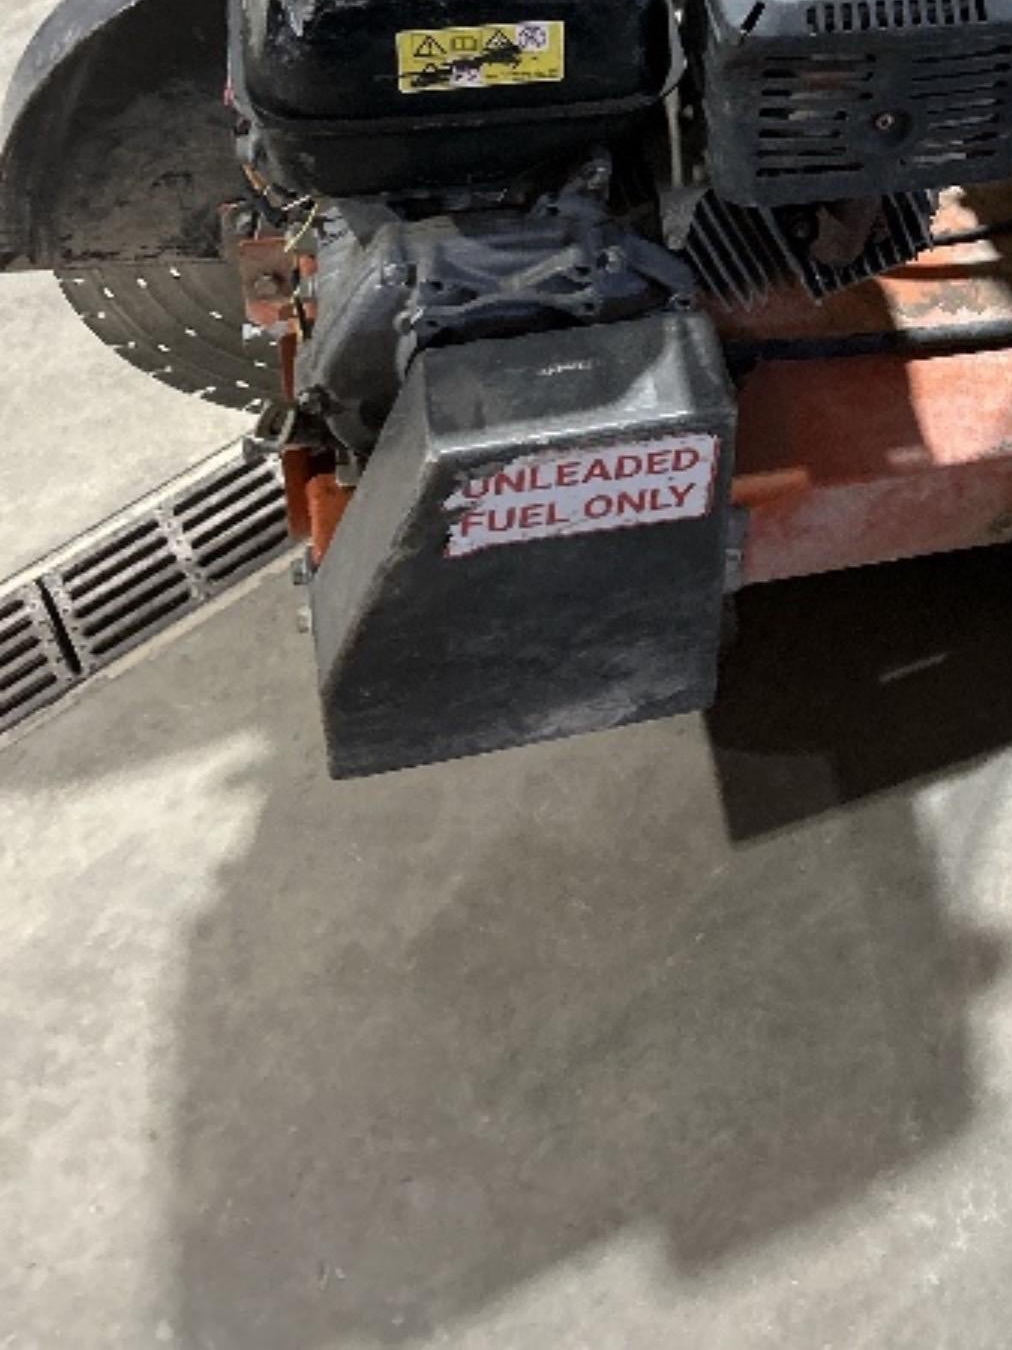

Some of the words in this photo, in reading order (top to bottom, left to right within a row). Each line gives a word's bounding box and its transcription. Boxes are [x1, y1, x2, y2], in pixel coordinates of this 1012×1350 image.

[461, 446, 700, 500] UNLEADED
[459, 501, 570, 538] FUEL
[583, 482, 697, 520] ONLY
